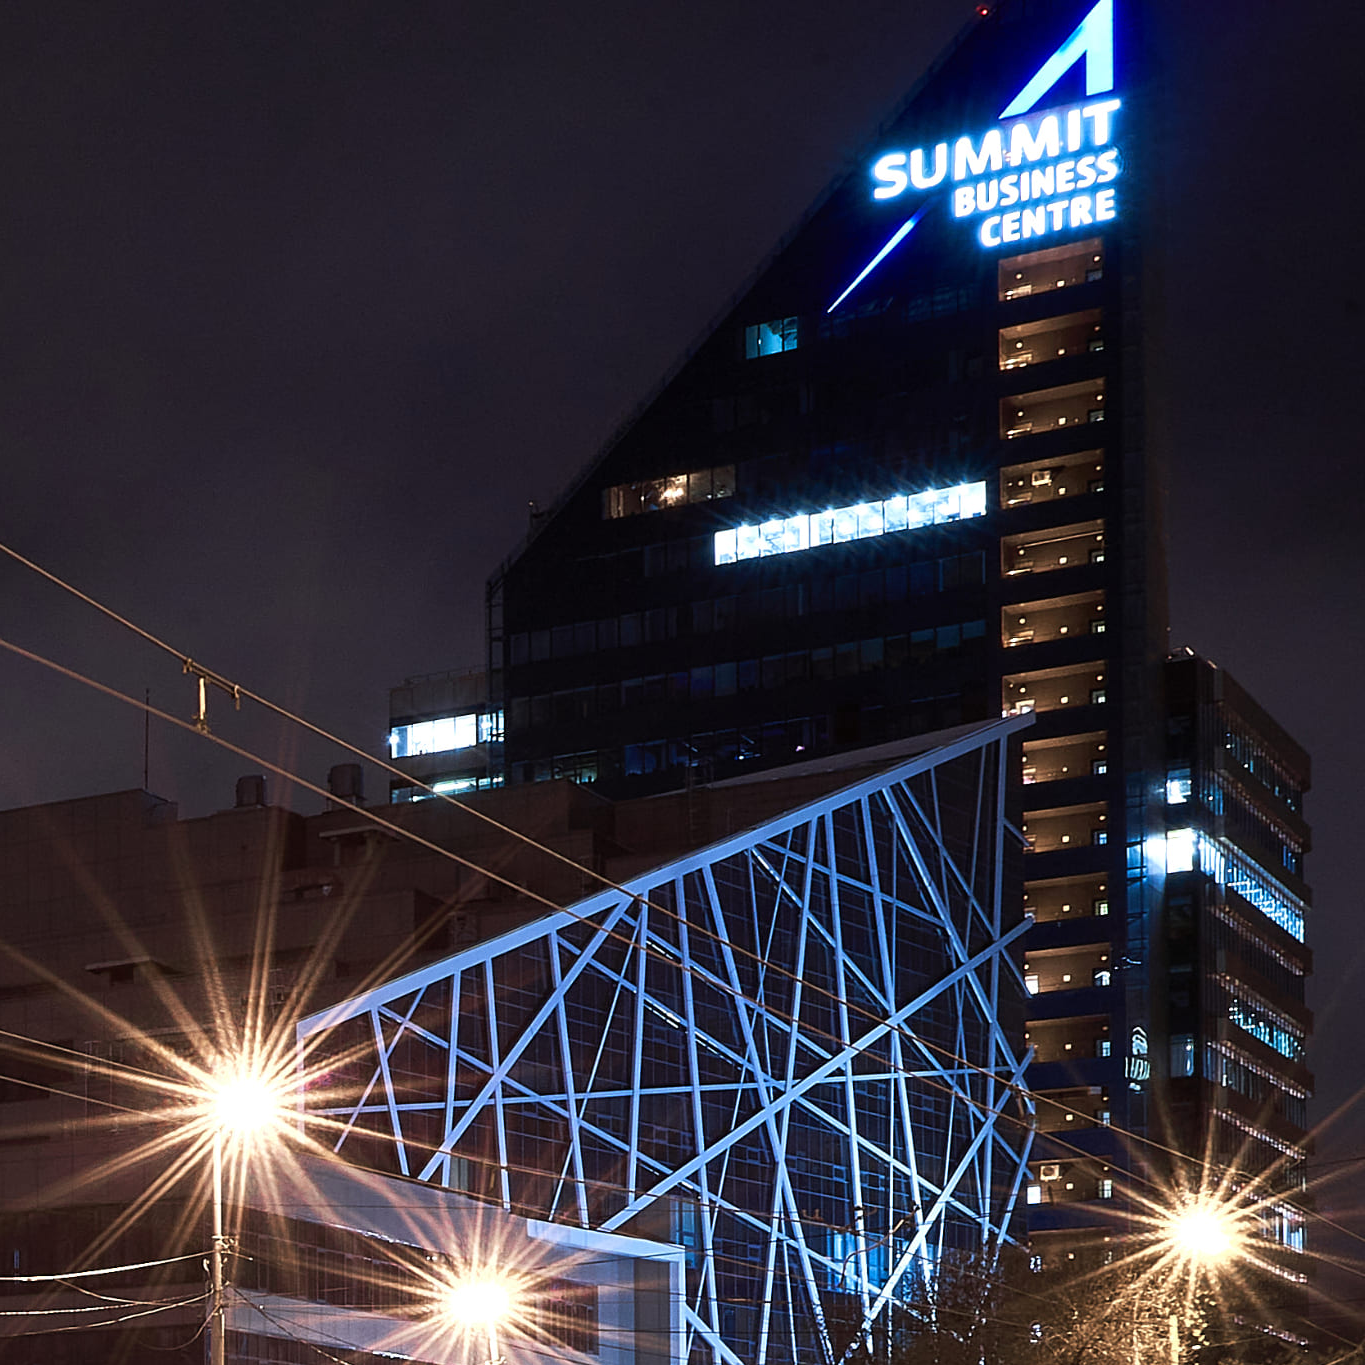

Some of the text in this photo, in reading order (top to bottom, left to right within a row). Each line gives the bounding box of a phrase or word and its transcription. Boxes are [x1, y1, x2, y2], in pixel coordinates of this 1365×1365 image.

[873, 99, 1121, 199] SUMMIT
[954, 150, 1118, 217] BUSINESS
[980, 189, 1116, 247] CENTRE
